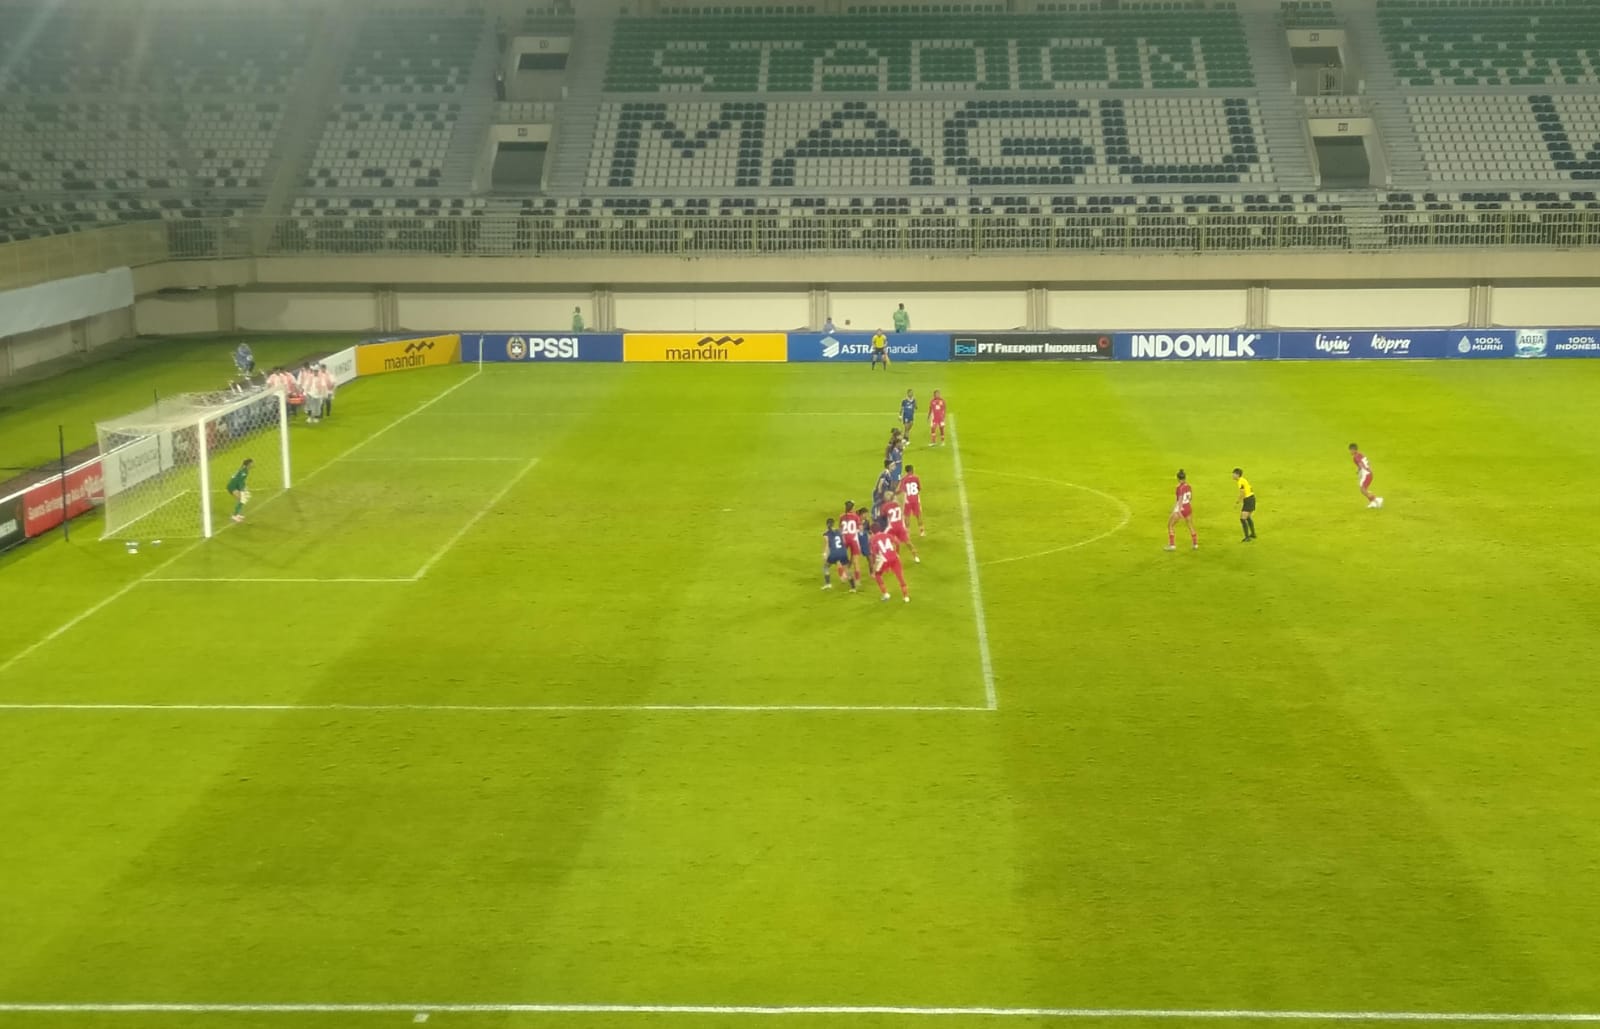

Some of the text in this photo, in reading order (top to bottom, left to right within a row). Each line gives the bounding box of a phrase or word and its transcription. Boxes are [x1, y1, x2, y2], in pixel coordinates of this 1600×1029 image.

[653, 38, 1209, 92] STADION
[608, 99, 1260, 186] MAGU
[529, 337, 579, 358] PSSI
[1131, 334, 1255, 358] INDOMILK
[1519, 335, 1545, 345] AQUA
[1567, 336, 1595, 344] 100%
[665, 345, 728, 360] mandiri
[841, 344, 918, 354] ASTRA nancial
[978, 343, 993, 353] PT
[384, 351, 425, 370] mandiri
[906, 482, 919, 496] 18
[888, 507, 901, 522] 27
[841, 520, 857, 534] 20
[835, 536, 842, 549] 2
[878, 538, 894, 553] 14
